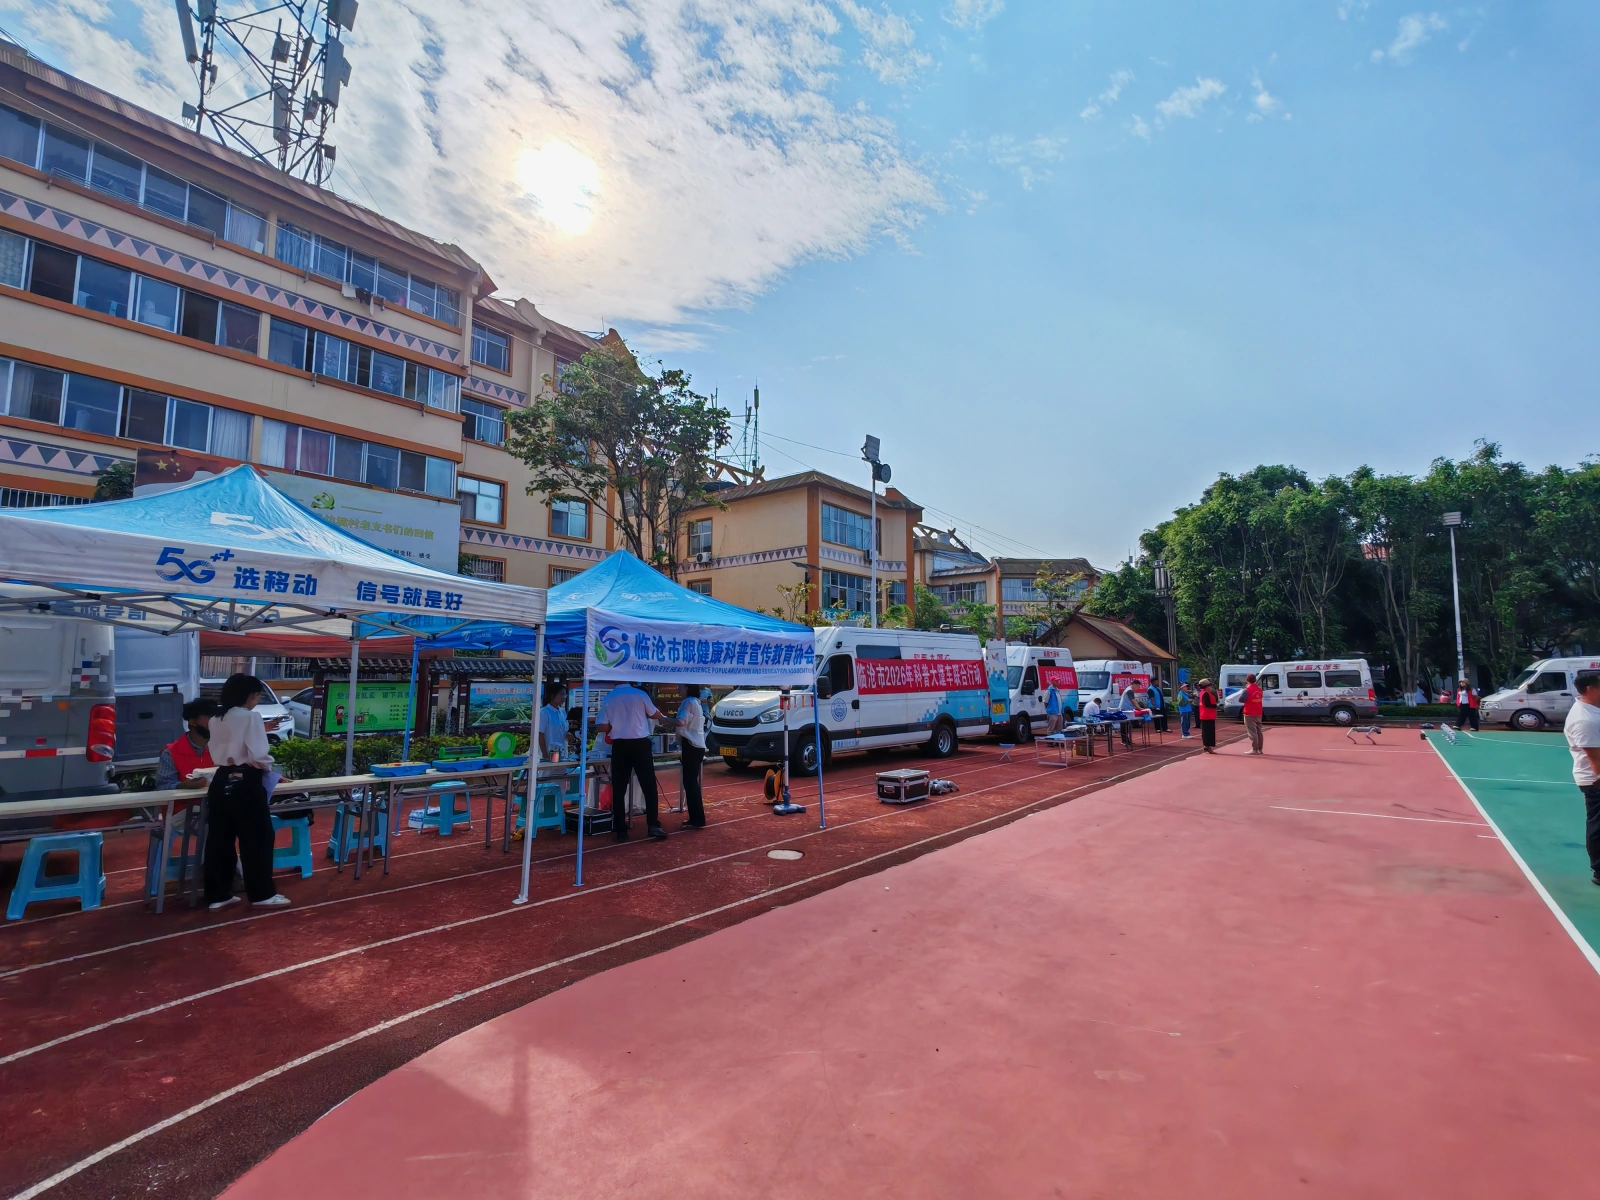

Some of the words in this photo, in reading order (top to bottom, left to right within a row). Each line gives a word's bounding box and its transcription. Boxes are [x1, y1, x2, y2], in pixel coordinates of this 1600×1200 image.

[233, 566, 318, 596] 选移动
[356, 580, 463, 611] 信号就是好
[635, 632, 815, 666] 临沧市眼健康科普宣传教育协会
[631, 663, 659, 672] LINCANG
[659, 665, 669, 673] EYE
[689, 666, 711, 674] SCIENCE
[711, 667, 752, 675] POPULARIZATION
[857, 662, 982, 690] 临沧市2026年科普大篷车联合行动
[723, 709, 744, 717] IVECO
